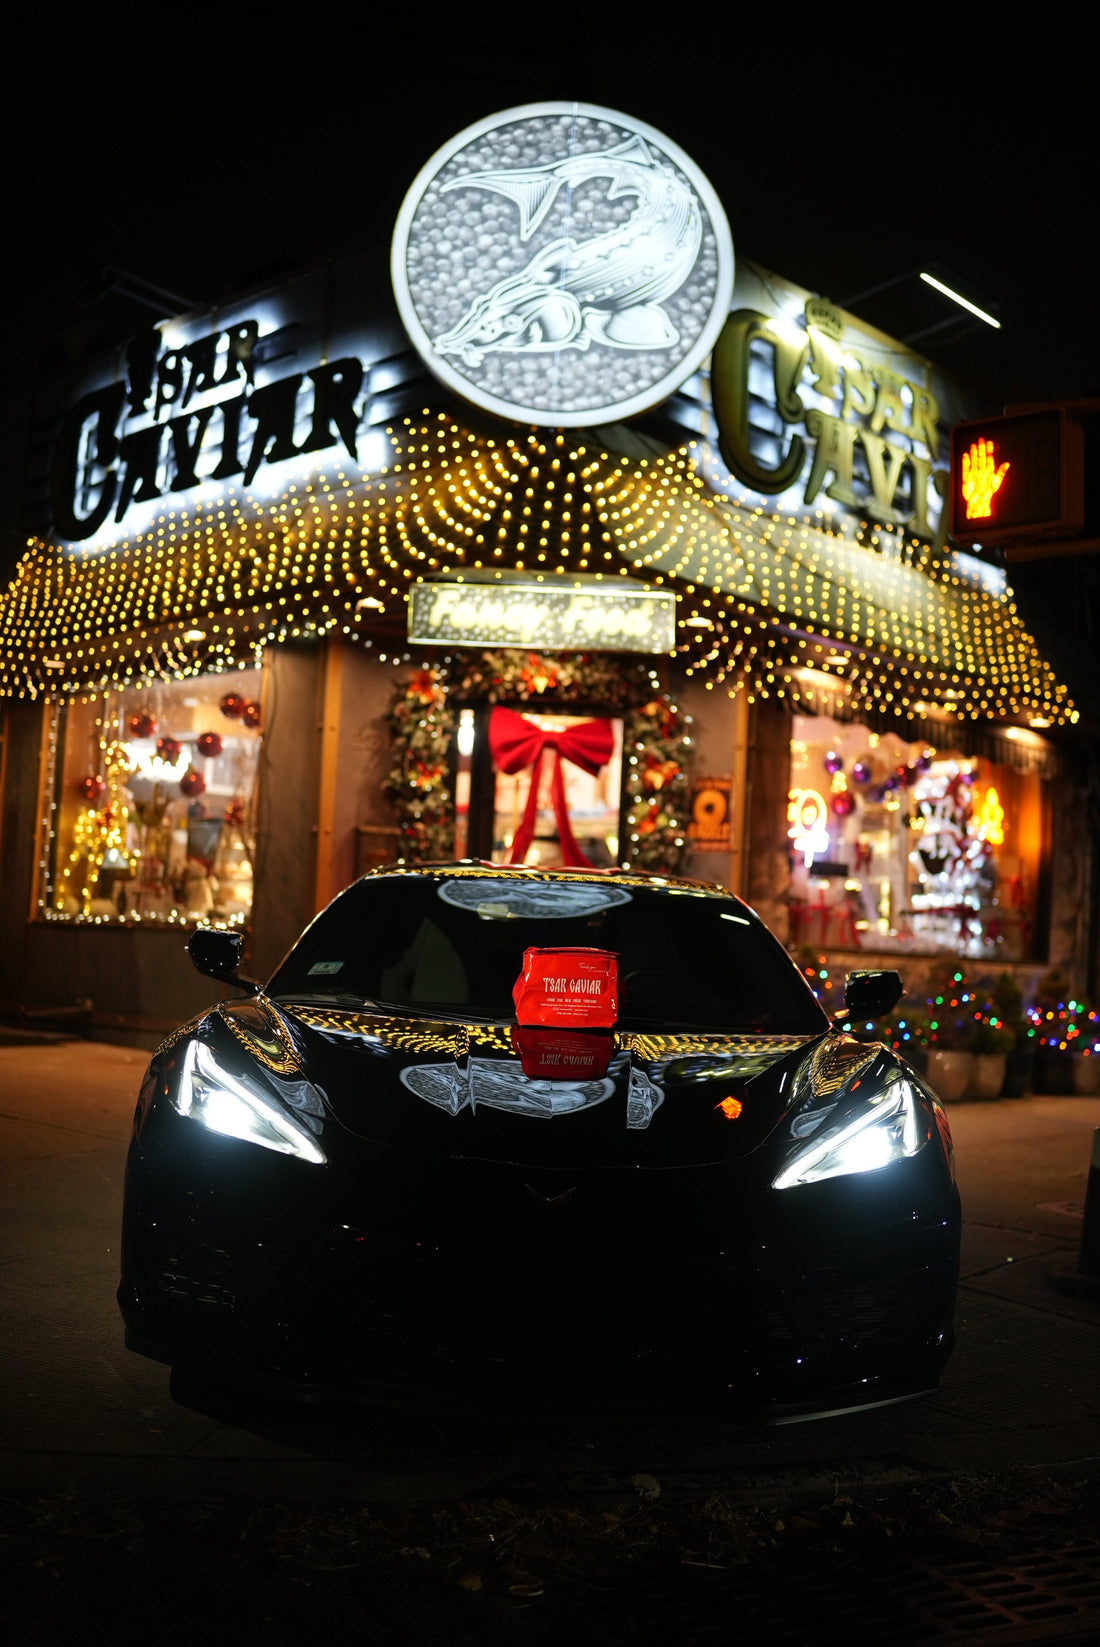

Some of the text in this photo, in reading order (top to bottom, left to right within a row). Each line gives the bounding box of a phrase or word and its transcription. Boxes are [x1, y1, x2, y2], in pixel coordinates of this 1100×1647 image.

[126, 320, 259, 420] TSAR
[711, 309, 951, 552] CAVI
[807, 325, 940, 461] TSAR
[50, 357, 364, 541] CAVIAR
[543, 977, 601, 995] TSAR CAVIAR
